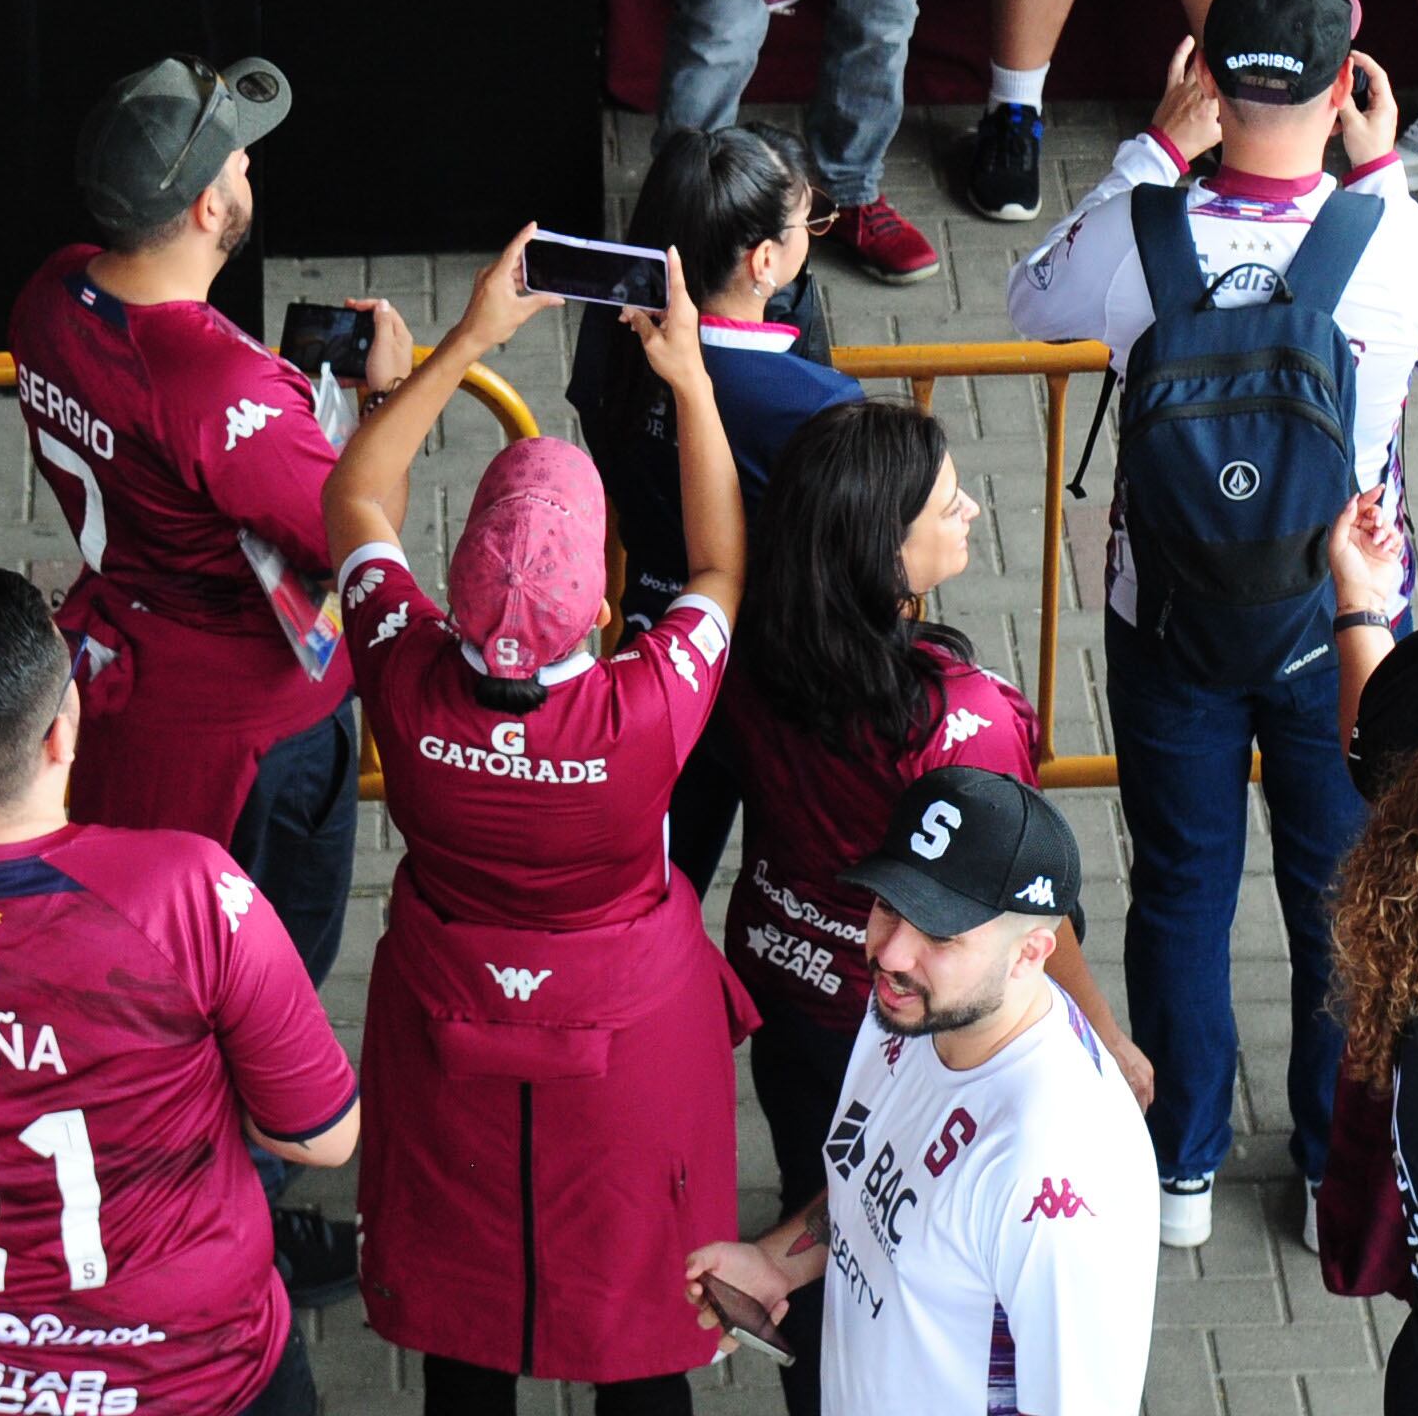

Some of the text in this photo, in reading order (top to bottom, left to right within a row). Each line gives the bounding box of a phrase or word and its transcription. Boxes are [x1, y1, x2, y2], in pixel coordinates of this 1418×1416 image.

[1226, 52, 1304, 75] SAPRISSA
[18, 362, 114, 461] SERGIO
[38, 427, 108, 576] 7
[496, 637, 519, 666] S
[1284, 643, 1329, 675] VOLCOM
[419, 736, 609, 785] GATORADE
[490, 721, 526, 755] G
[910, 799, 963, 861] S
[763, 923, 834, 970] STAR
[801, 902, 868, 945] Pinos
[767, 943, 843, 996] CARS
[924, 1106, 978, 1178] S
[864, 1140, 918, 1248] BAC
[83, 1262, 96, 1281] S
[30, 1313, 166, 1346] Pinos
